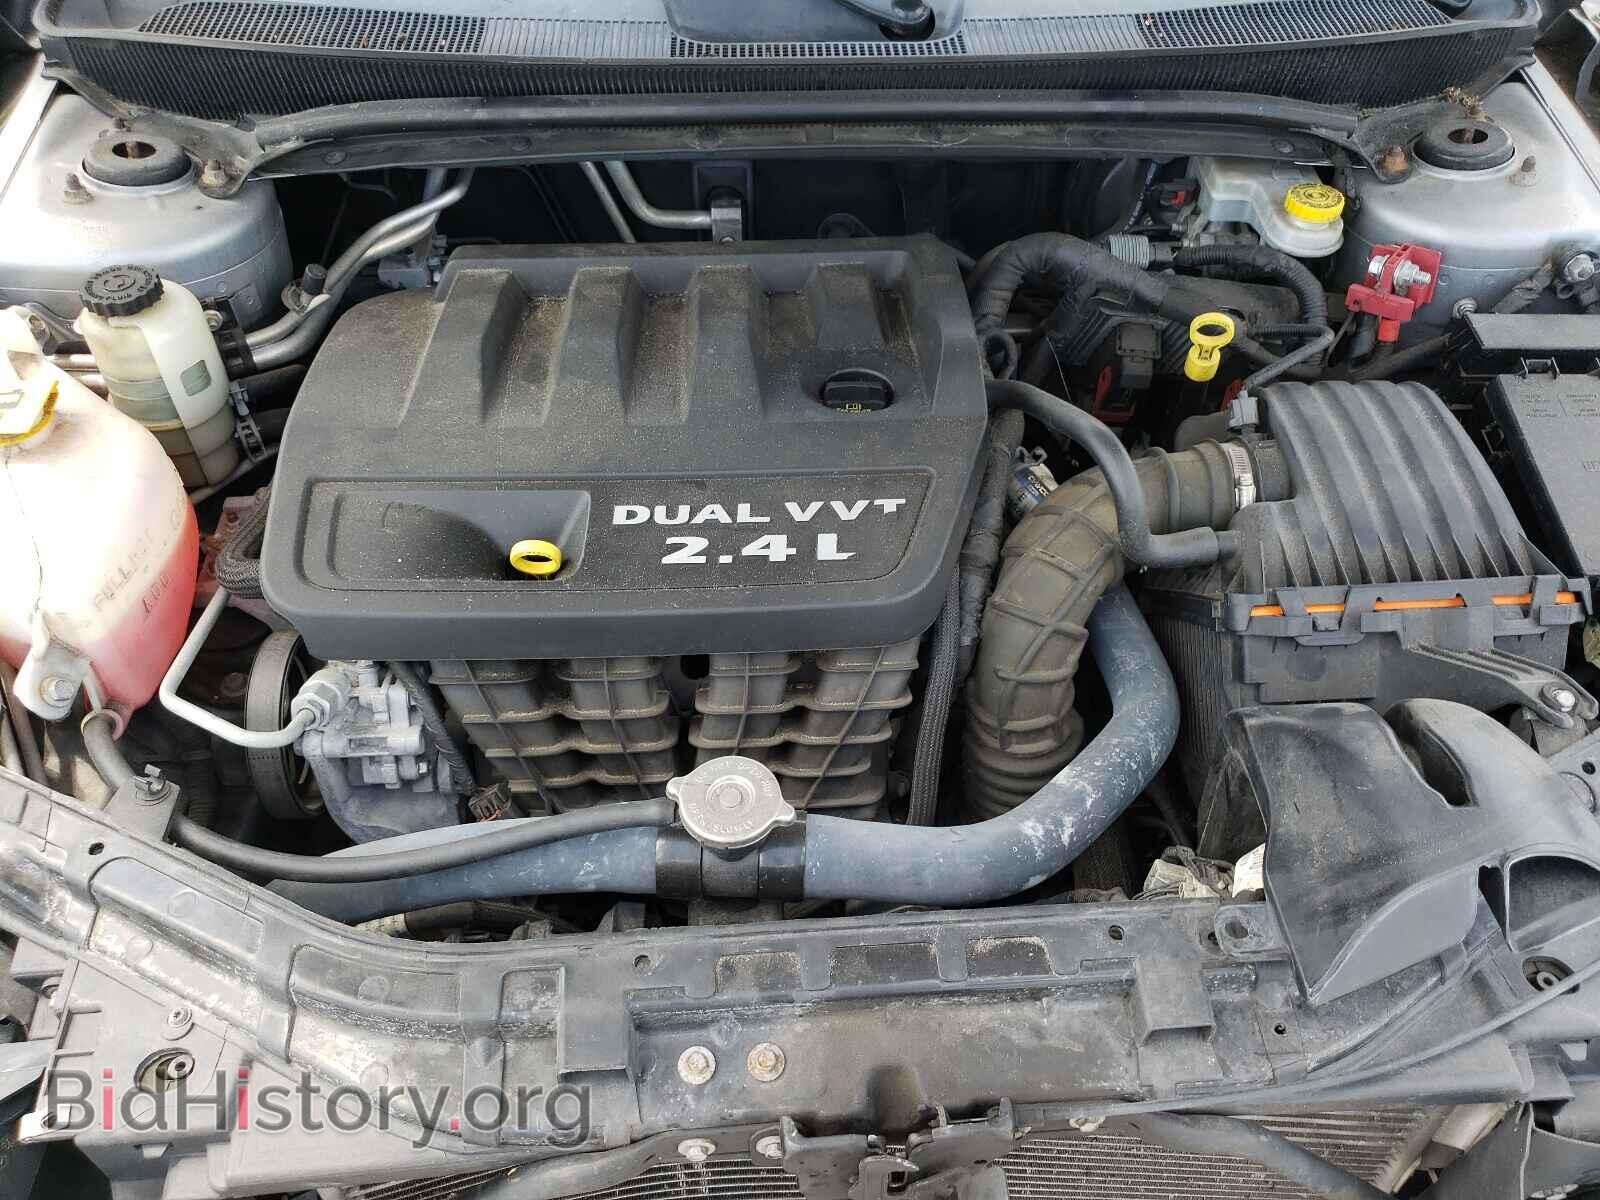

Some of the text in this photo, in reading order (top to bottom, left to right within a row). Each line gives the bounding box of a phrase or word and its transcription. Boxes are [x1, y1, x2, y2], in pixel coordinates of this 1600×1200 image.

[612, 498, 907, 525] DUAL VVT
[661, 533, 857, 564] 2.4 L
